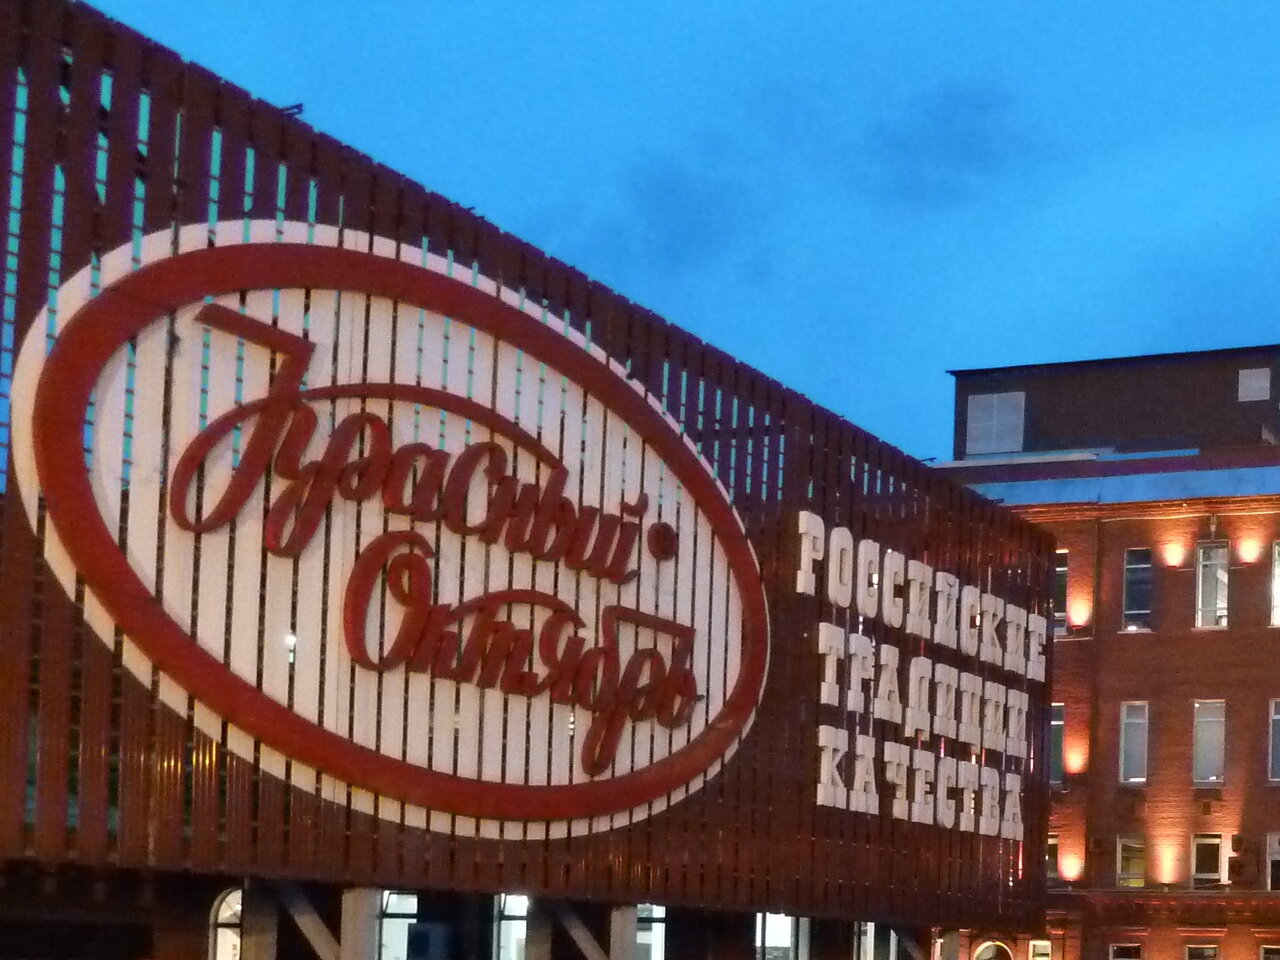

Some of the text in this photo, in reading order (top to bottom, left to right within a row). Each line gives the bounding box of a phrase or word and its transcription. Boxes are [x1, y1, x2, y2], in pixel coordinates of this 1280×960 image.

[344, 530, 704, 776] Октябрь
[796, 510, 1047, 683] РОССИЙСКИЕ
[818, 622, 1029, 759] ТРАДИЦИИ
[816, 724, 1025, 841] КАЧЕСТВА
